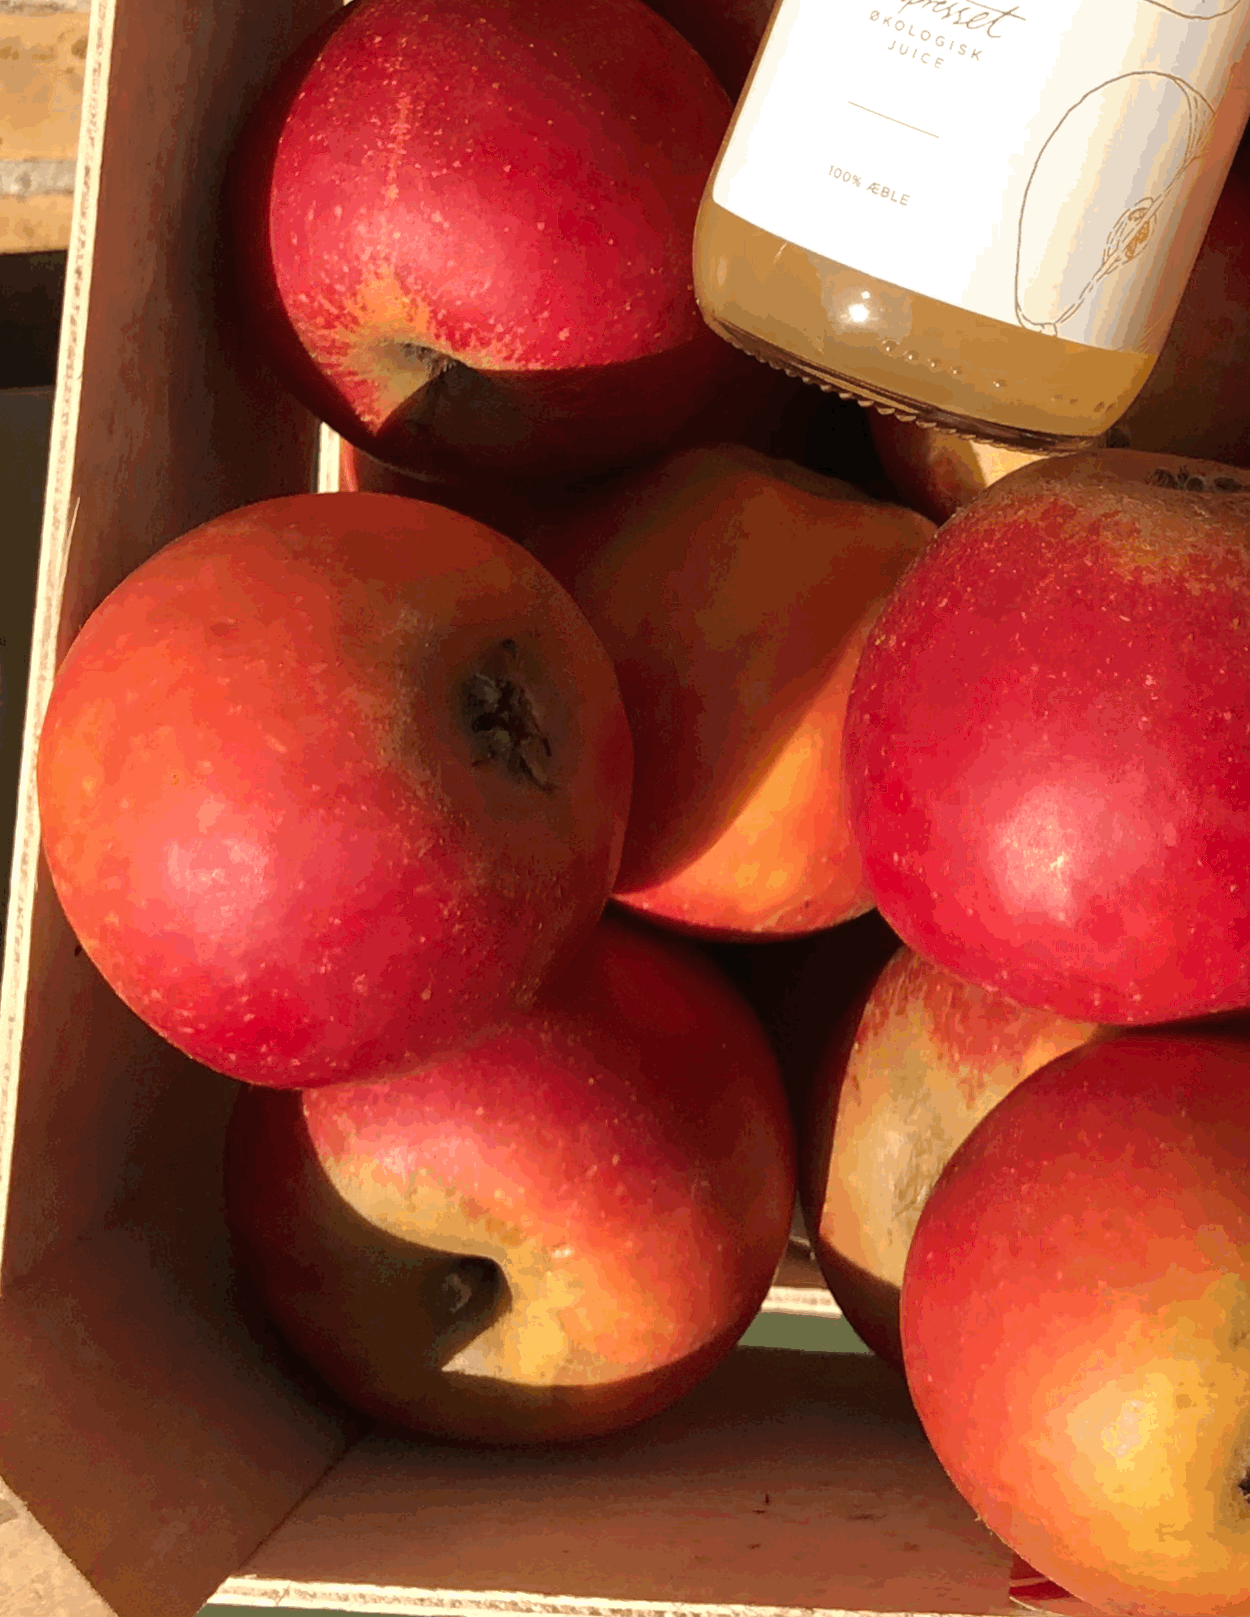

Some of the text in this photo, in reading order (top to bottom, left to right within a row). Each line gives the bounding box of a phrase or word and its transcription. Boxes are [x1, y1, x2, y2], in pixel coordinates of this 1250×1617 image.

[869, 10, 983, 61] ØKOLOGISK
[887, 40, 945, 69] JUICE
[828, 165, 911, 206] 100% ÆBLE
